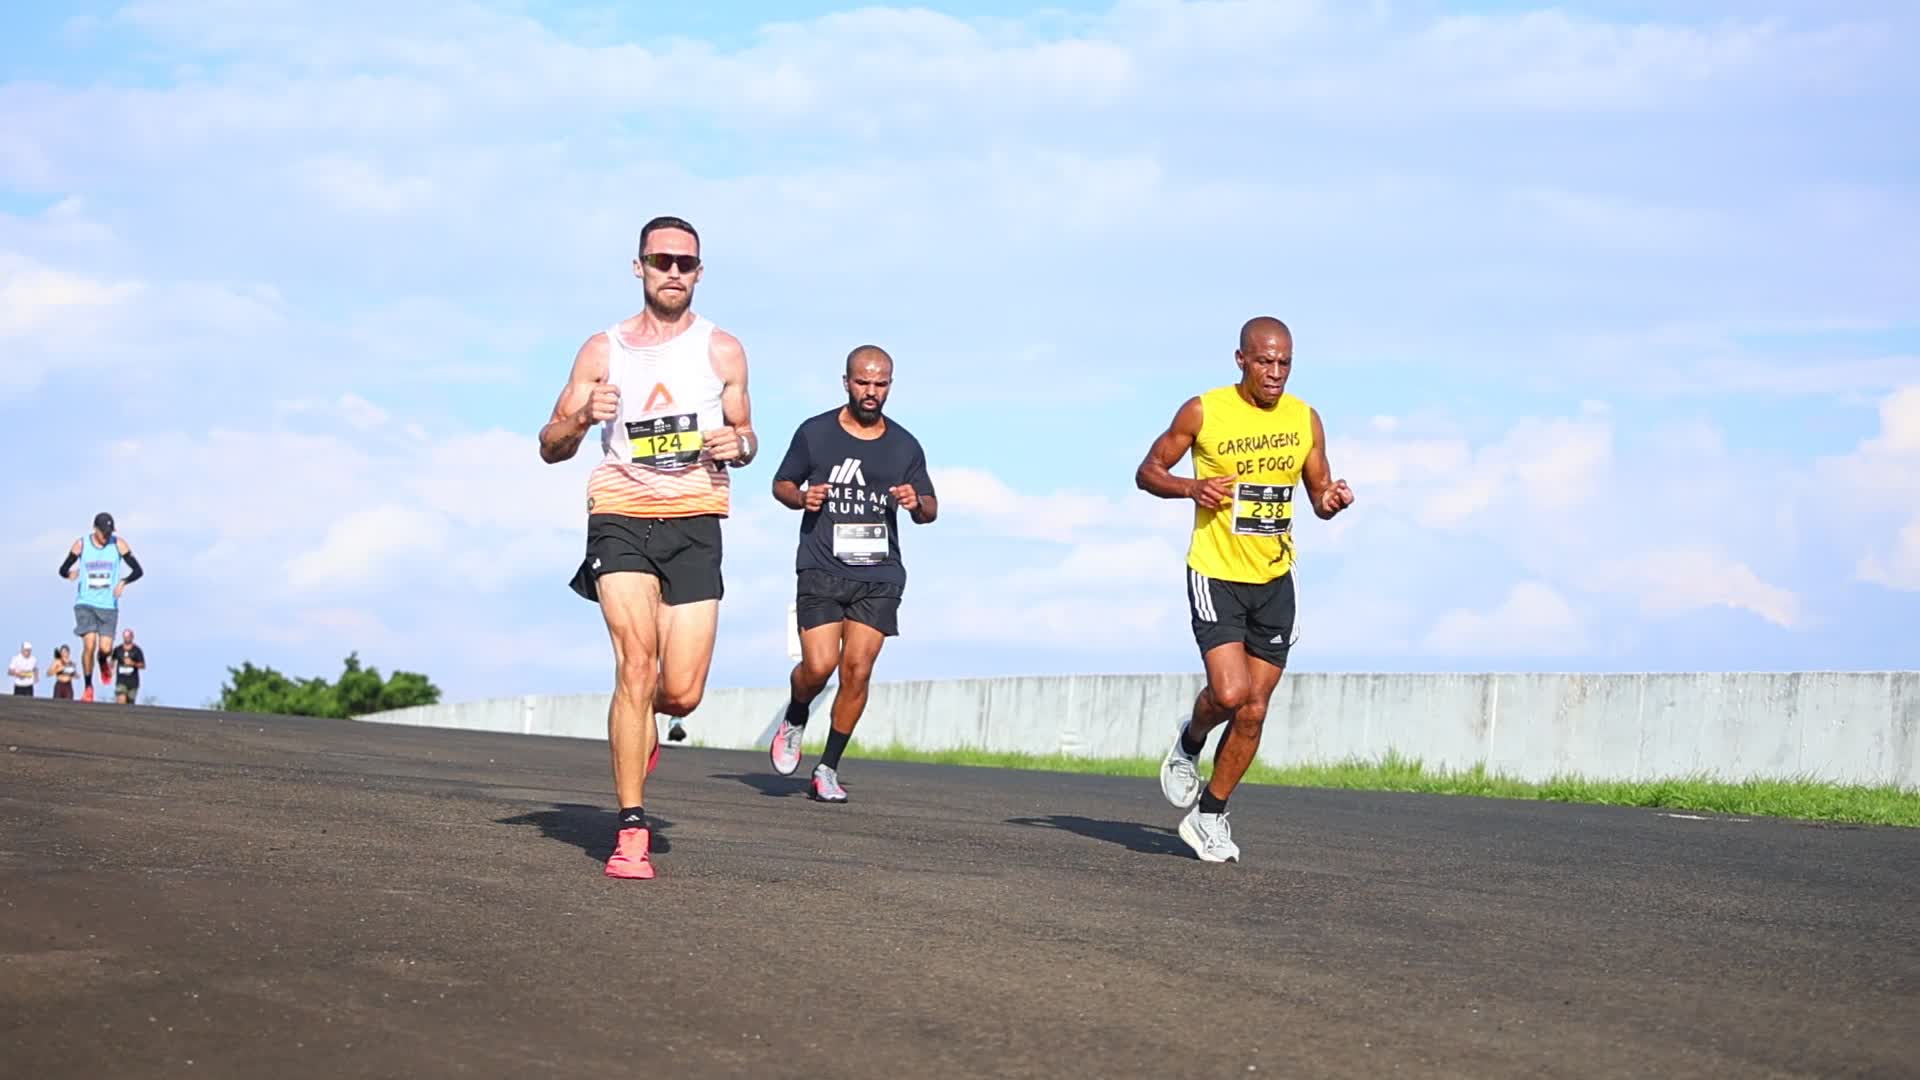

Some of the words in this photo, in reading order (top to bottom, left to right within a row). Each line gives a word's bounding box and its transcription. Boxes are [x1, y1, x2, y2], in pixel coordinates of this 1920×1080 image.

[648, 434, 682, 455] 124
[1217, 432, 1300, 456] CARRUAGENS
[1236, 460, 1254, 476] DE
[1258, 455, 1295, 474] FOGO
[828, 487, 888, 506] MERAK
[828, 501, 865, 515] RUN
[1251, 502, 1285, 519] 238
